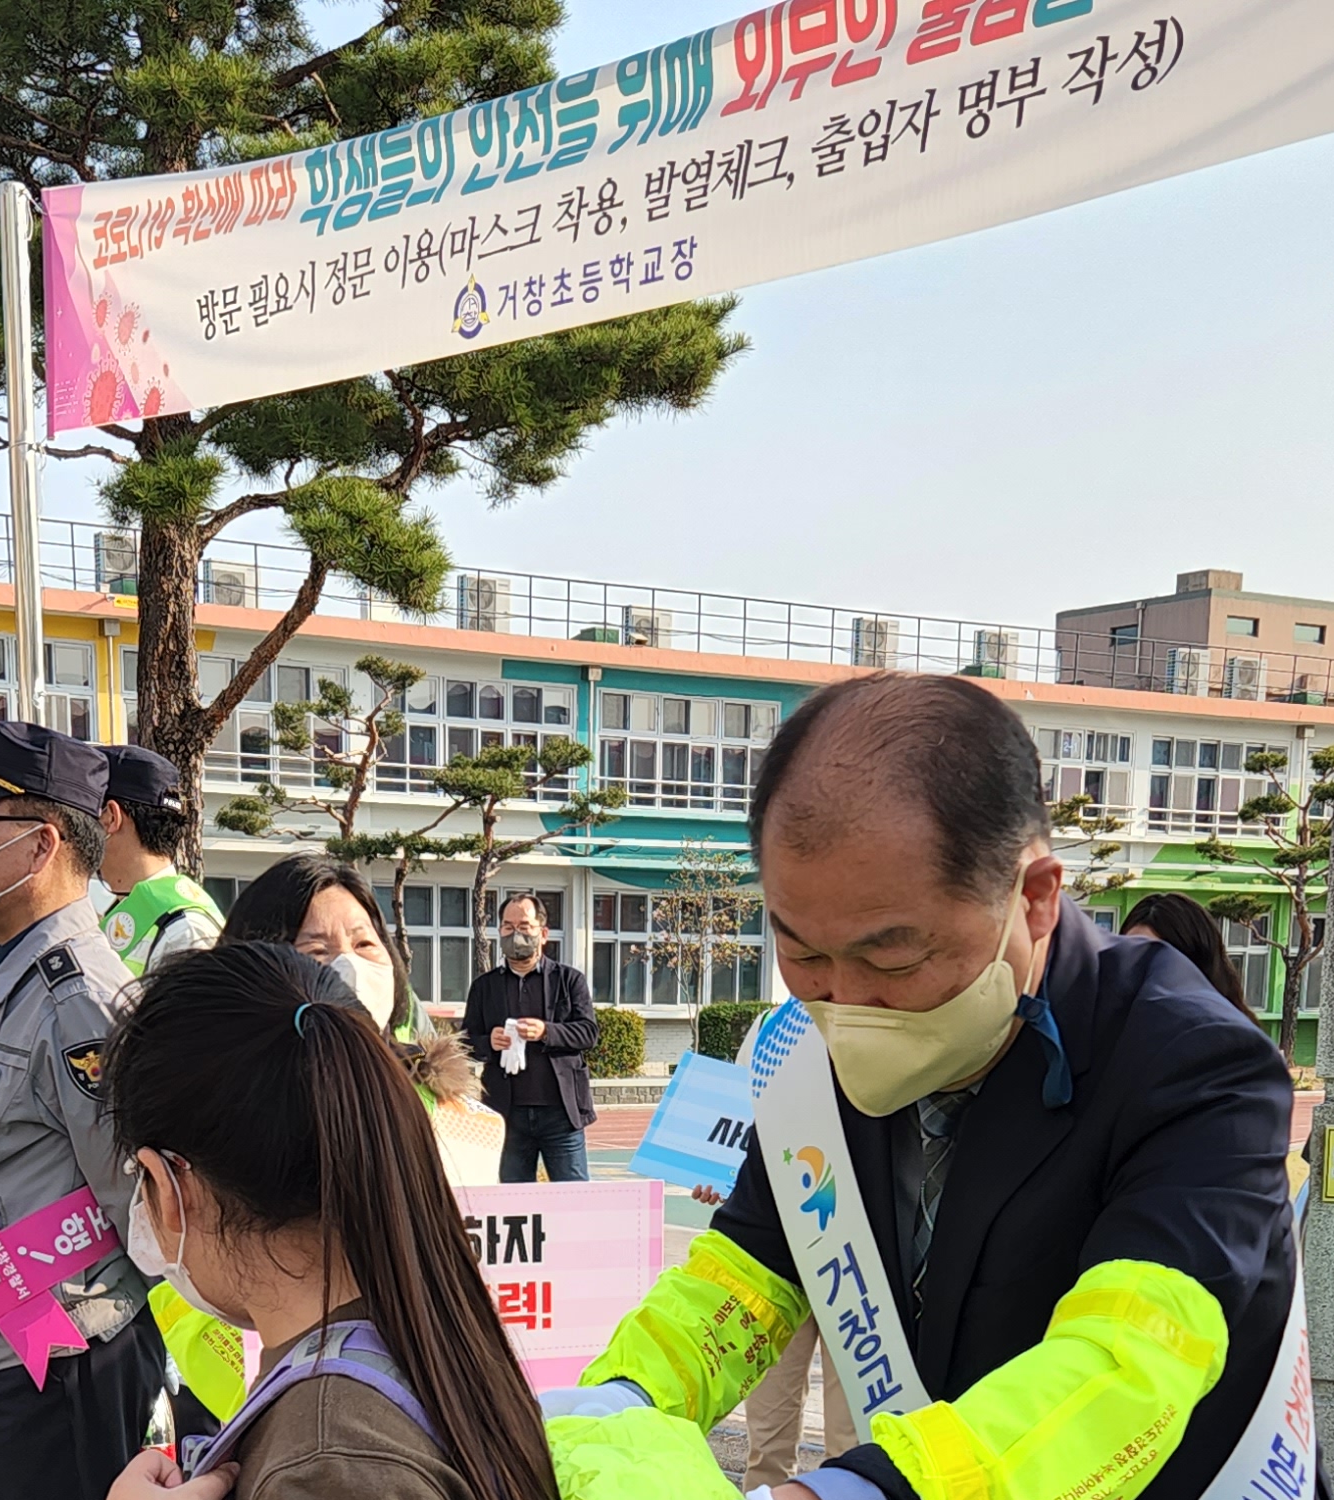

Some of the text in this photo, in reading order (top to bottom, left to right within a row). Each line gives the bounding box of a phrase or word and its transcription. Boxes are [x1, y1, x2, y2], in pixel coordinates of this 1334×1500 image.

[93, 197, 175, 270] 코로나19
[172, 170, 244, 245] 확산에
[243, 156, 297, 227] 따라
[300, 111, 456, 236] 학생들의
[463, 68, 600, 197] 안전을
[610, 27, 714, 156] 위해
[720, 0, 898, 117] 외부인
[196, 15, 1185, 343] 방문 필요시 정문 이용(마스크 착용, 발열체크, 출입자 명부 작성)
[494, 235, 700, 324] 거창초등학교장
